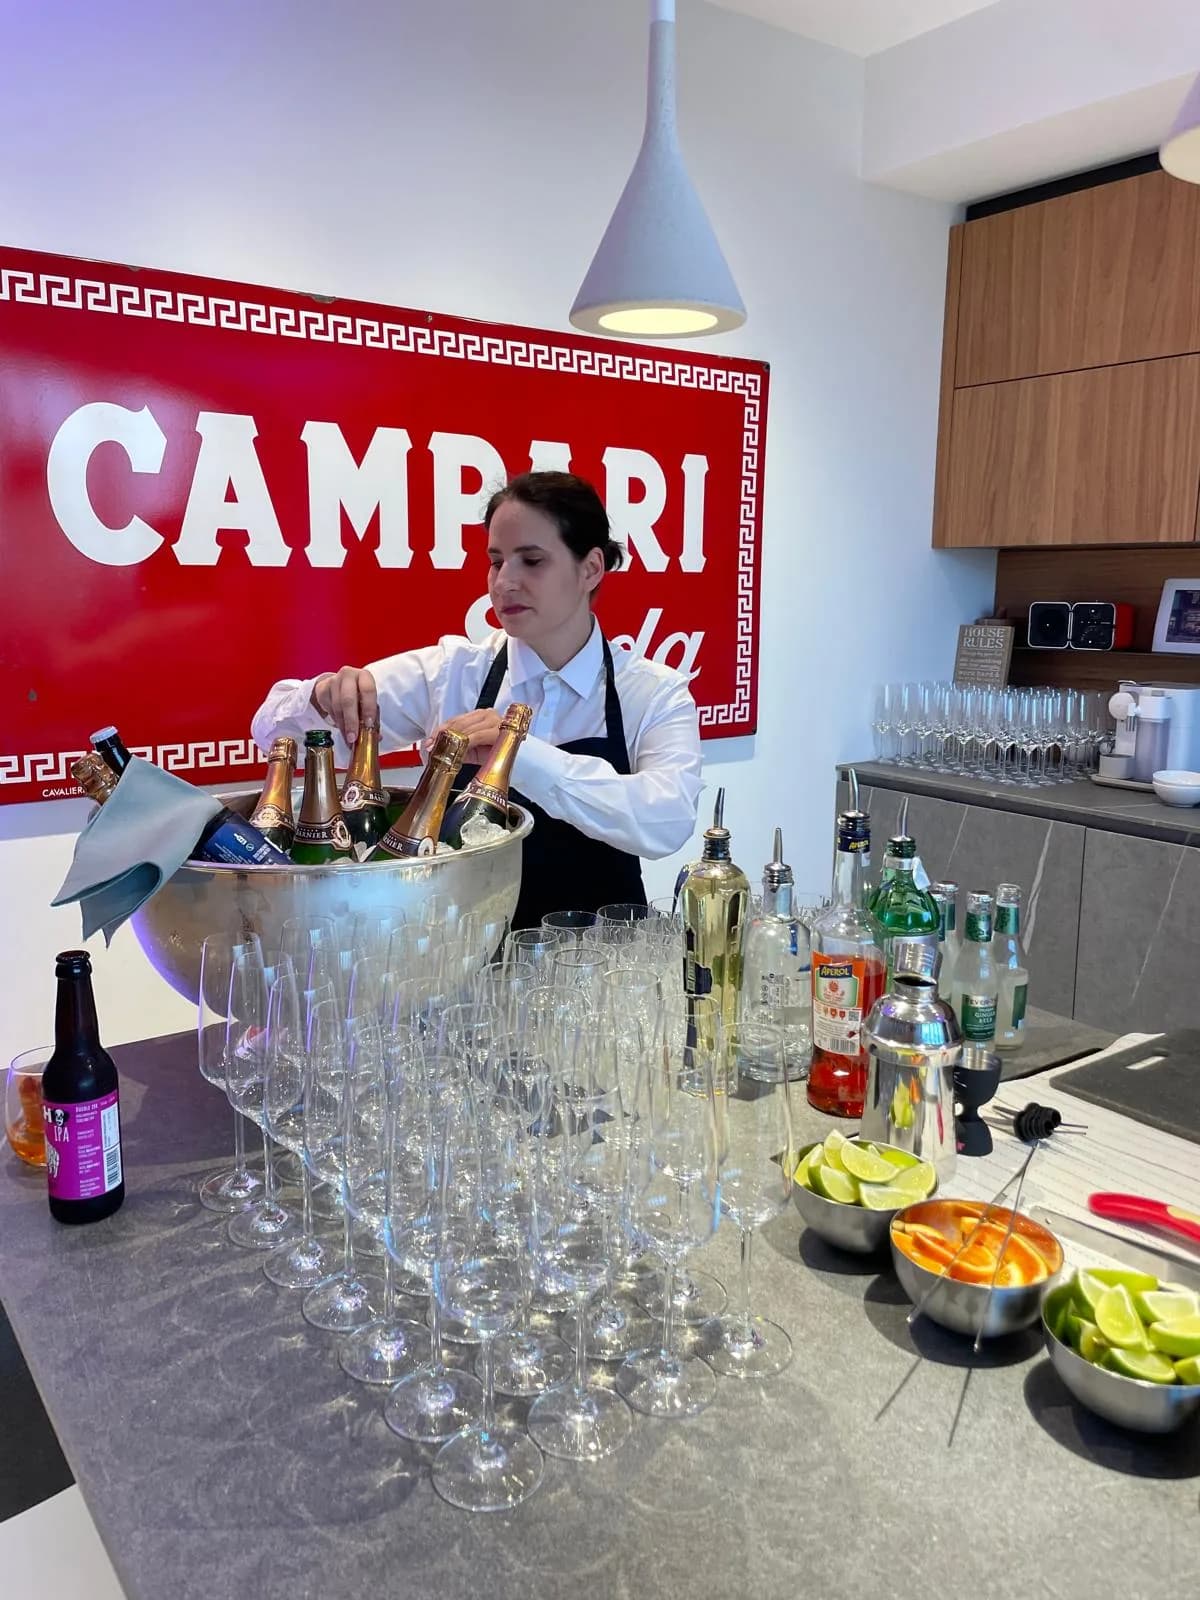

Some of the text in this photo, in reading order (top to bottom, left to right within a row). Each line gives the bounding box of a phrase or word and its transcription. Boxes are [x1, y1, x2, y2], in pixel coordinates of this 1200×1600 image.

[47, 402, 709, 573] CAMPRI
[465, 594, 705, 680] da
[964, 627, 1004, 638] HOUSE
[963, 637, 1003, 648] RULES
[42, 786, 86, 798] CAVALIER
[821, 966, 850, 977] APEROL
[54, 1125, 69, 1142] IPA
